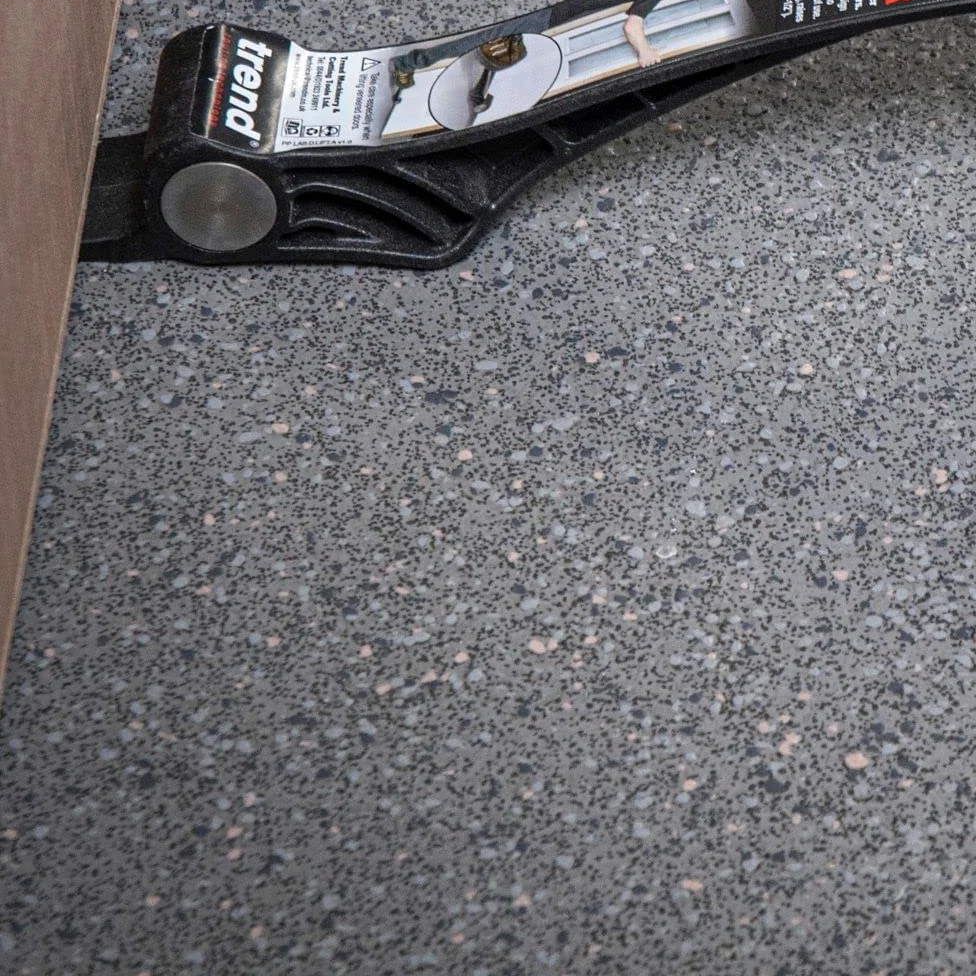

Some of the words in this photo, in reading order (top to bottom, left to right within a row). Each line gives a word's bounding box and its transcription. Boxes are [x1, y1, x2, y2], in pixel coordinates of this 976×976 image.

[795, 3, 806, 23] raises
[325, 57, 336, 78] Cutting
[339, 56, 348, 73] Trend
[225, 38, 272, 141] trend
[324, 80, 333, 96] Tools
[332, 75, 345, 106] Machinery
[322, 97, 331, 109] Ltd.
[363, 98, 375, 125] especially
